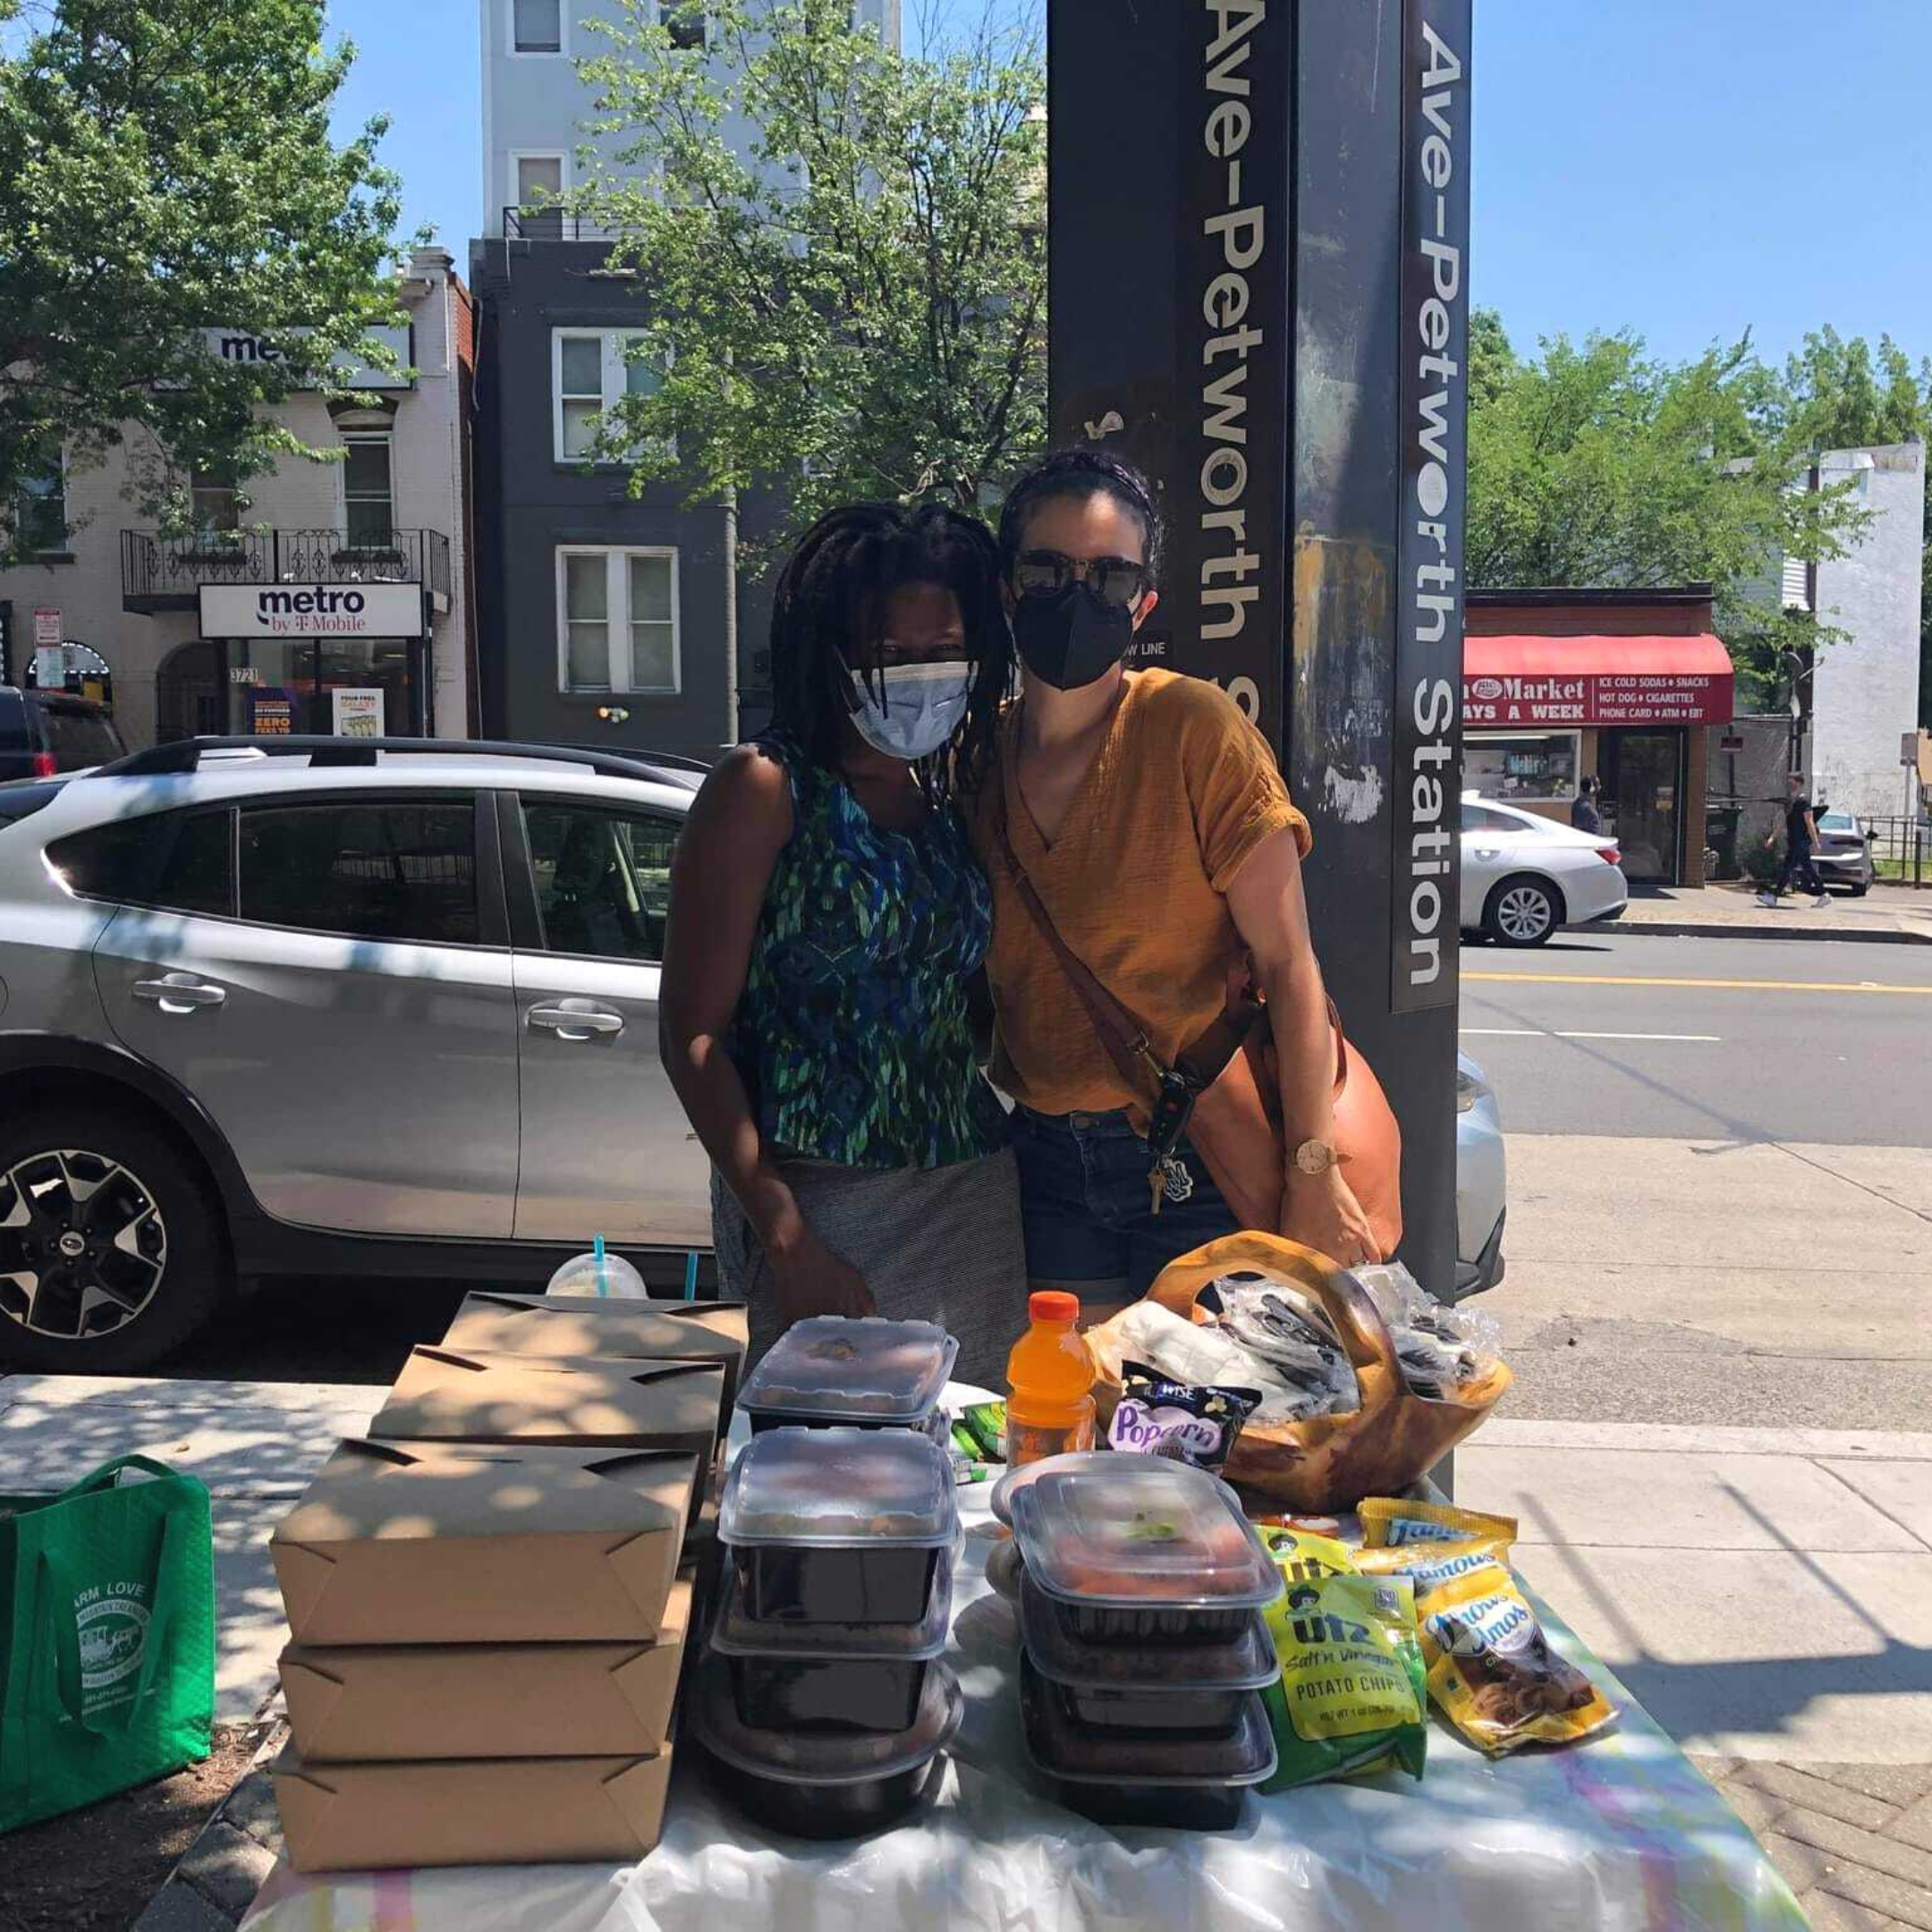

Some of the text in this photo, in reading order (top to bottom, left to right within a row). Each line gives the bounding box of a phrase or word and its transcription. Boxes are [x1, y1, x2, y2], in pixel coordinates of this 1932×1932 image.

[258, 586, 365, 614] metro
[272, 616, 291, 633] by
[1141, 642, 1165, 655] LINE
[230, 668, 258, 682] 3721
[1599, 677, 1709, 687] ICE COLD SODAS SNACKS
[1504, 677, 1585, 699] Market
[1599, 693, 1694, 703] HOT DOG CIGARETTES
[1462, 704, 1585, 719] AYS A WEEK
[1599, 708, 1626, 718] PHONE
[1629, 708, 1652, 718] CARD
[1661, 708, 1680, 718] ATM
[1410, 676, 1455, 986] Station
[106, 1581, 147, 1598] LOVE
[1296, 1677, 1354, 1701] POTATO
